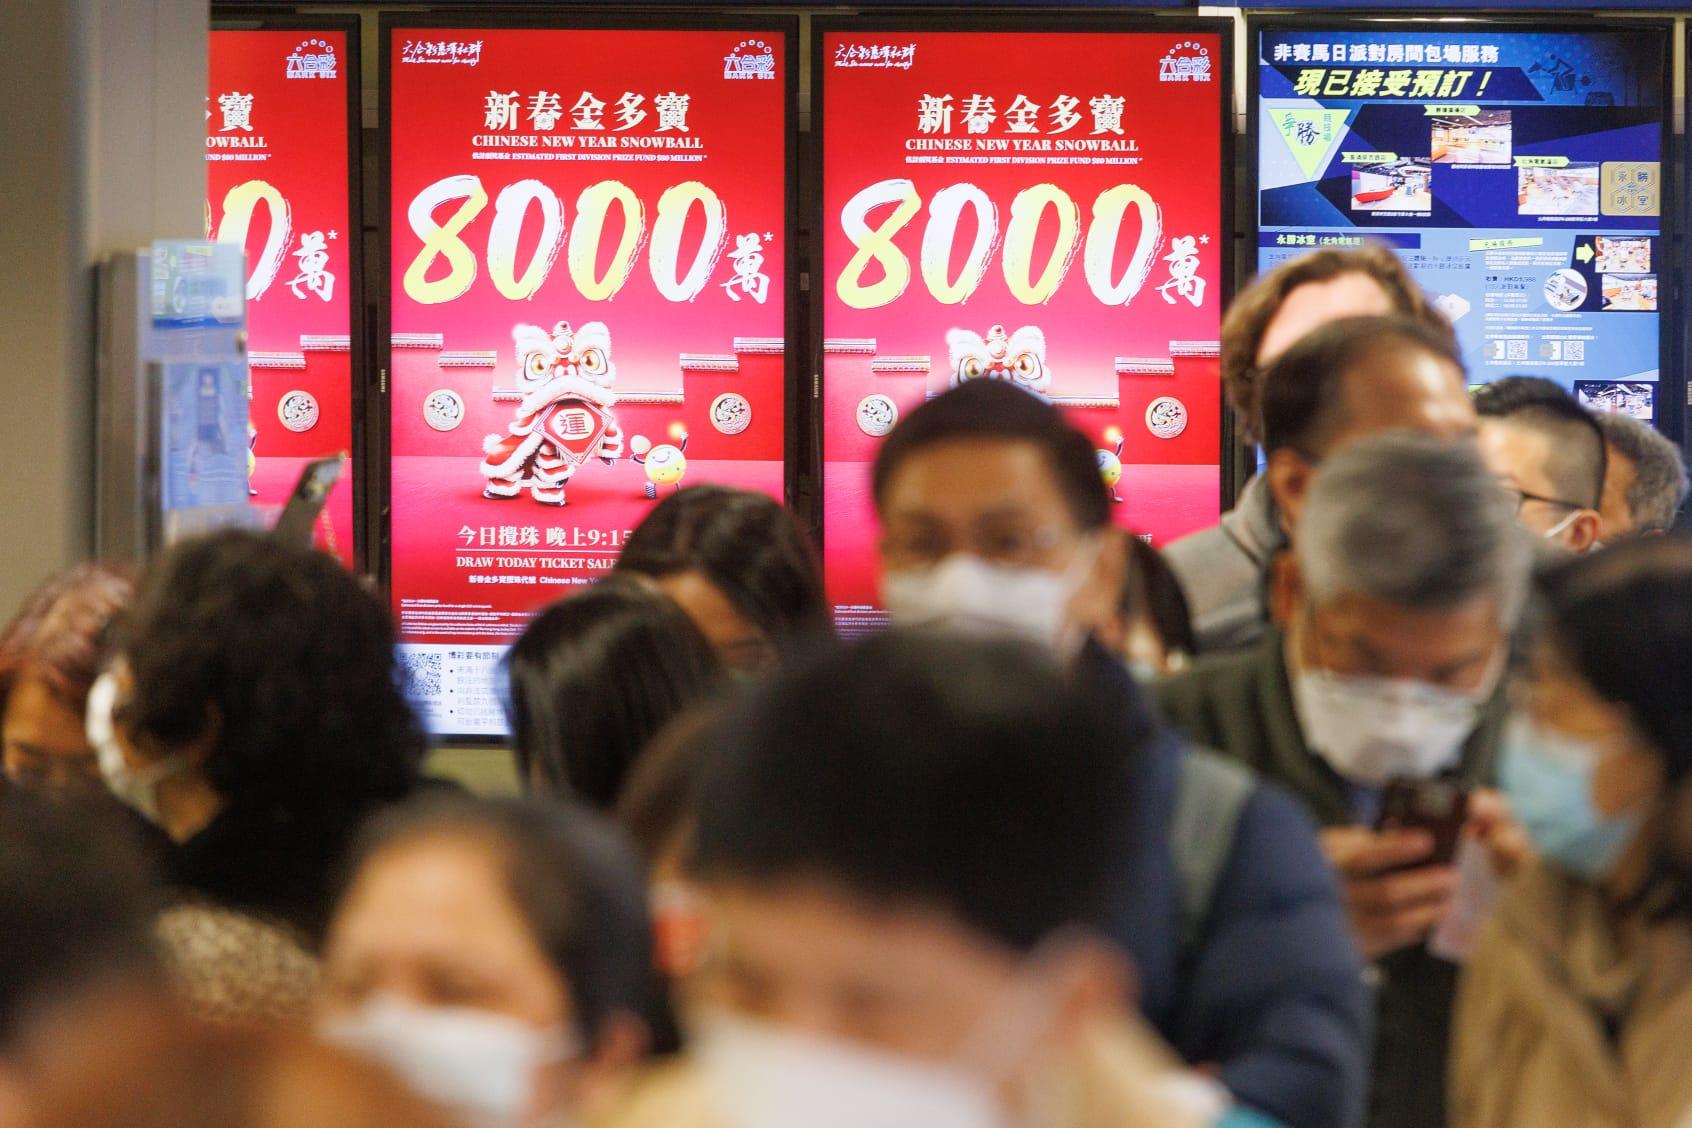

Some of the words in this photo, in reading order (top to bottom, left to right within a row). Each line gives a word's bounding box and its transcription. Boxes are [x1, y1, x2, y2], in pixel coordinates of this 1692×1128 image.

[724, 53, 775, 71] 六合彩
[1160, 55, 1211, 73] 六合彩
[484, 90, 691, 132] 新春金多寶
[917, 93, 1127, 136] 新春金多寶
[206, 137, 267, 148] OWBALL
[472, 135, 538, 147] CHINESE
[542, 136, 577, 148] NEW
[578, 136, 618, 148] YEAR
[620, 136, 704, 149] SNOWBALL
[905, 138, 973, 150] CHINESE
[976, 139, 1010, 150] NEW
[1012, 139, 1052, 151] YEAR
[1055, 139, 1139, 152] SNOWBALL
[559, 412, 588, 435] 運
[457, 525, 540, 546] 今日攪珠
[456, 557, 494, 568] DRAW
[496, 557, 538, 569] TODAY
[539, 558, 585, 569] TICKET
[539, 576, 571, 585] Chinese
